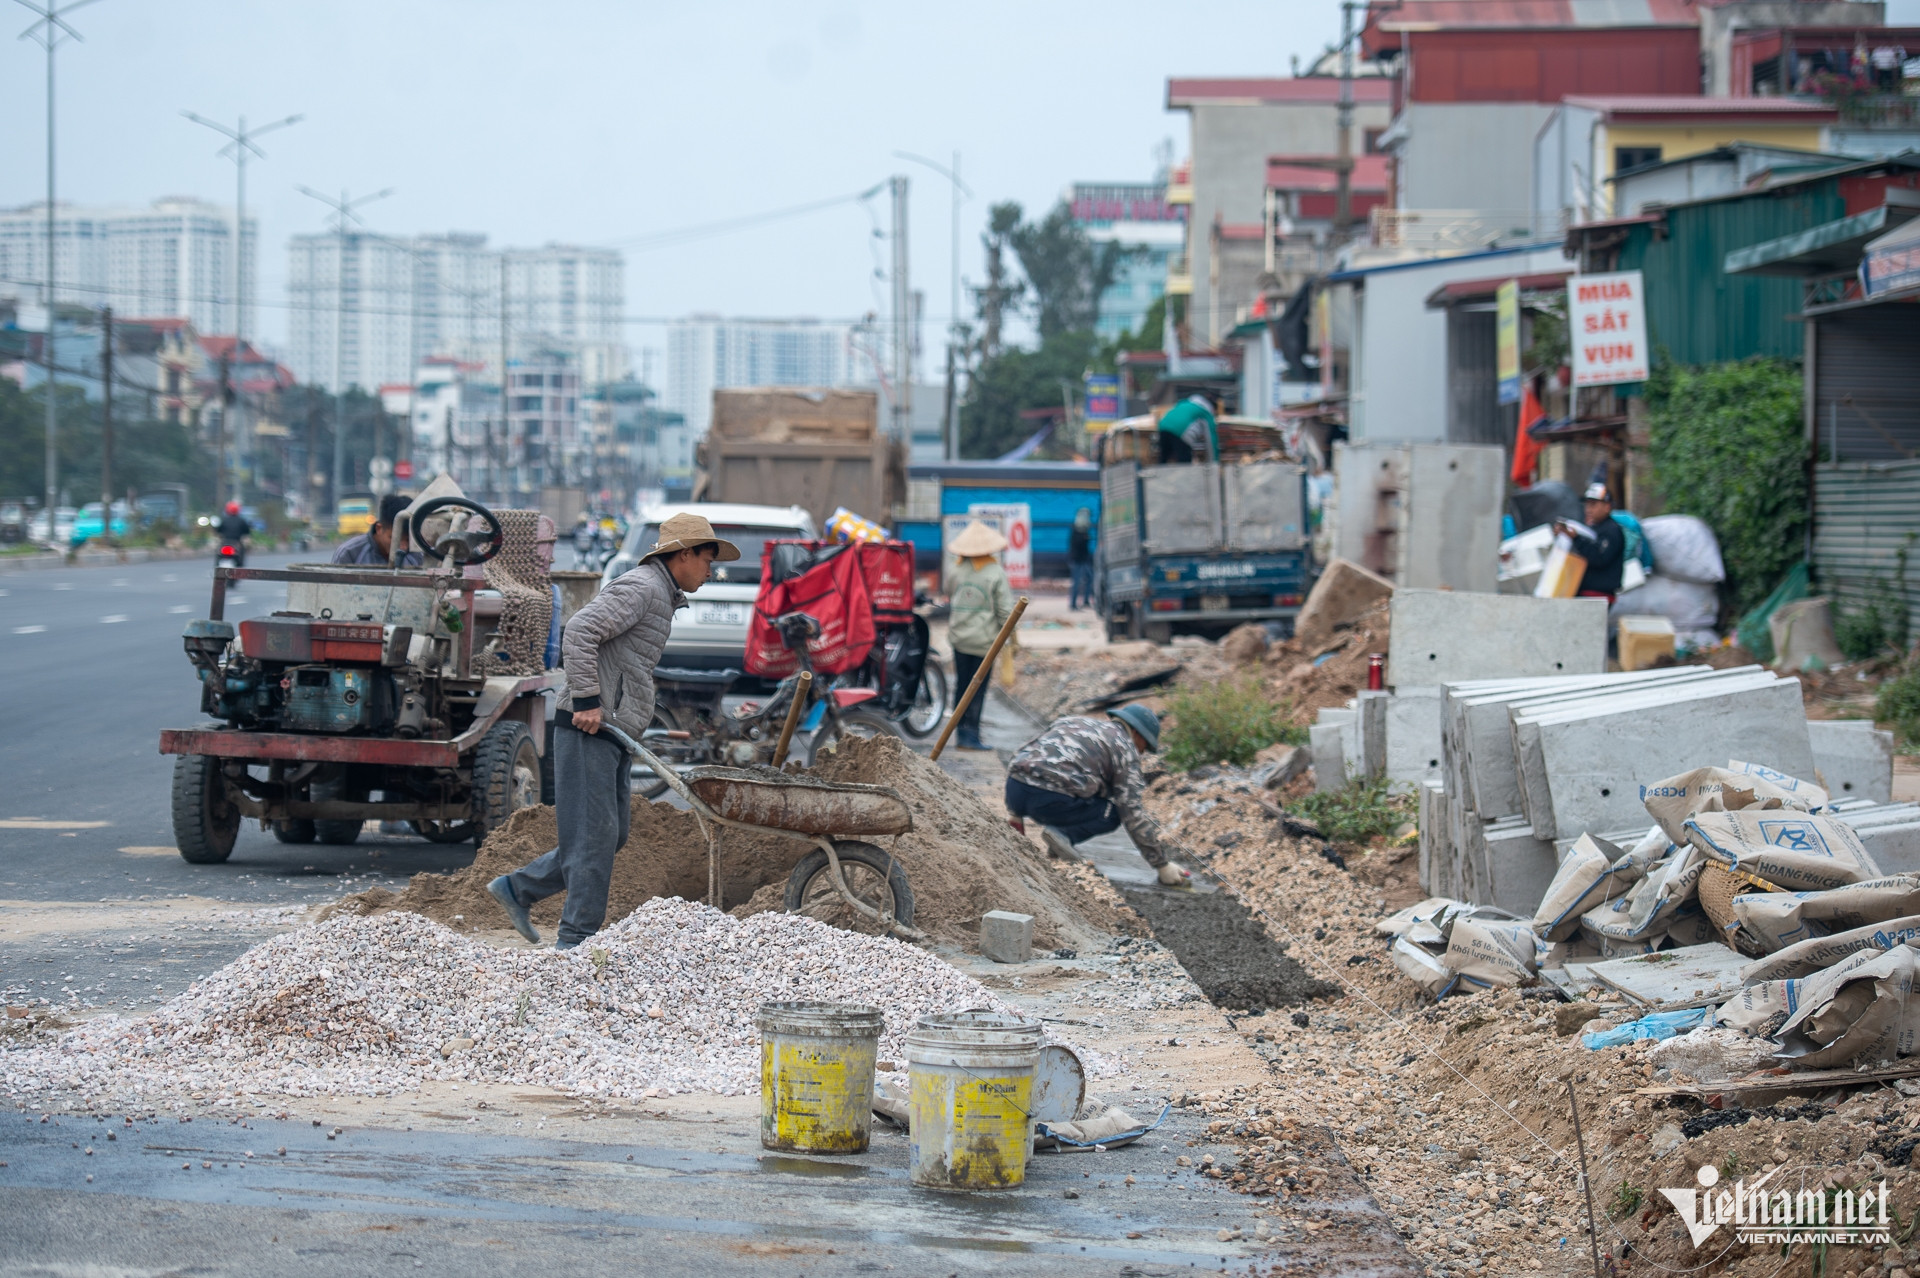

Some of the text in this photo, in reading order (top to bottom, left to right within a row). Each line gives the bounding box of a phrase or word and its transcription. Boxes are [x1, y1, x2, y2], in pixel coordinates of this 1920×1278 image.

[1578, 283, 1633, 303] MUA
[1585, 308, 1629, 334] SẮT
[1584, 342, 1634, 366] VỤN
[1759, 862, 1801, 880] HOANG
[1452, 943, 1470, 956] Khối
[1471, 949, 1496, 963] lượng
[1498, 956, 1514, 969] tịnh
[1830, 935, 1879, 957] CEMENT
